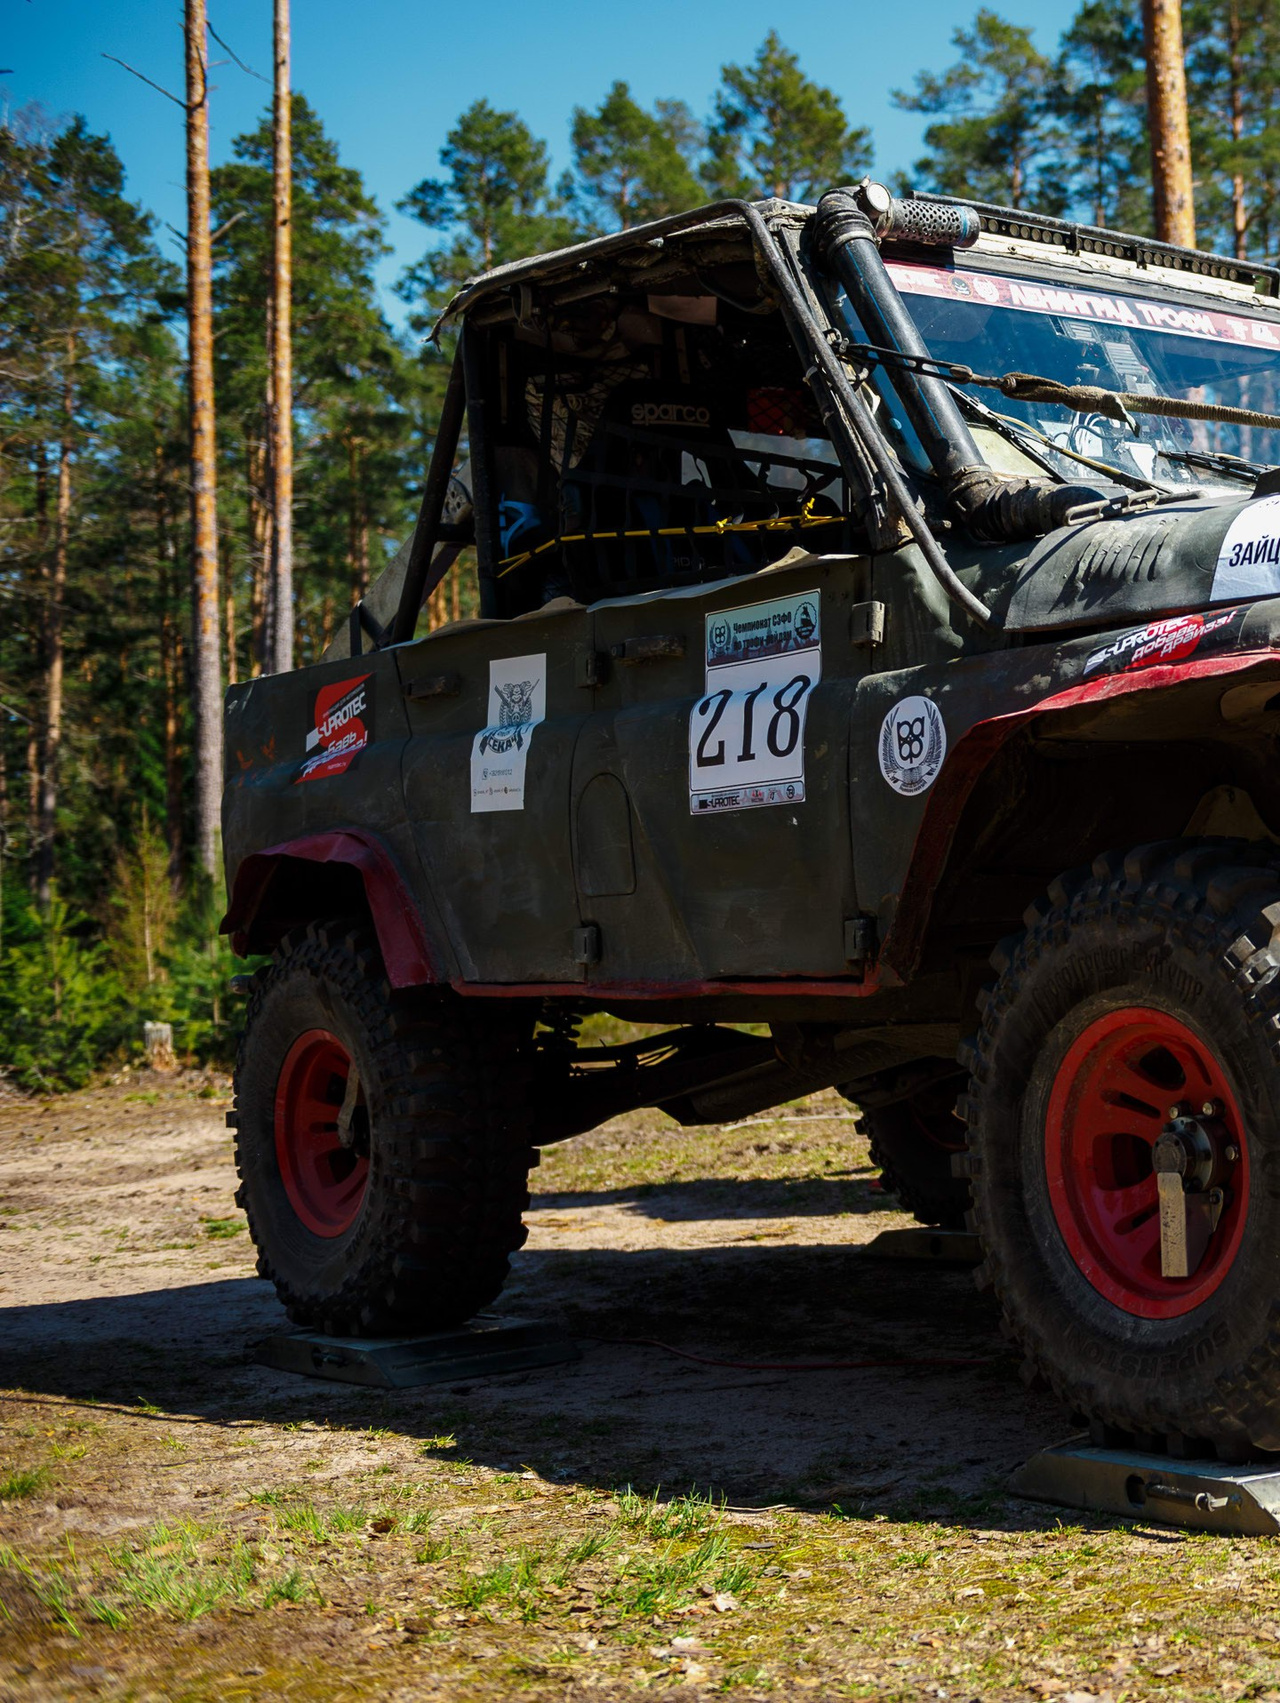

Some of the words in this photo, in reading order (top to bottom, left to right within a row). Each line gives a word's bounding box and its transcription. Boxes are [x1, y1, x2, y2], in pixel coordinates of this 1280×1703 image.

[1008, 284, 1142, 325] ЛЕНИНГРАД
[1136, 303, 1218, 336] ТРОФИ
[630, 402, 711, 426] sparco
[733, 616, 772, 634] Чемпионат
[772, 611, 792, 627] СЗФО
[1103, 614, 1193, 657] SUPROTEC
[317, 691, 367, 738] SUPROTEC
[696, 674, 811, 768] 218
[706, 795, 740, 808] SUPROTEC
